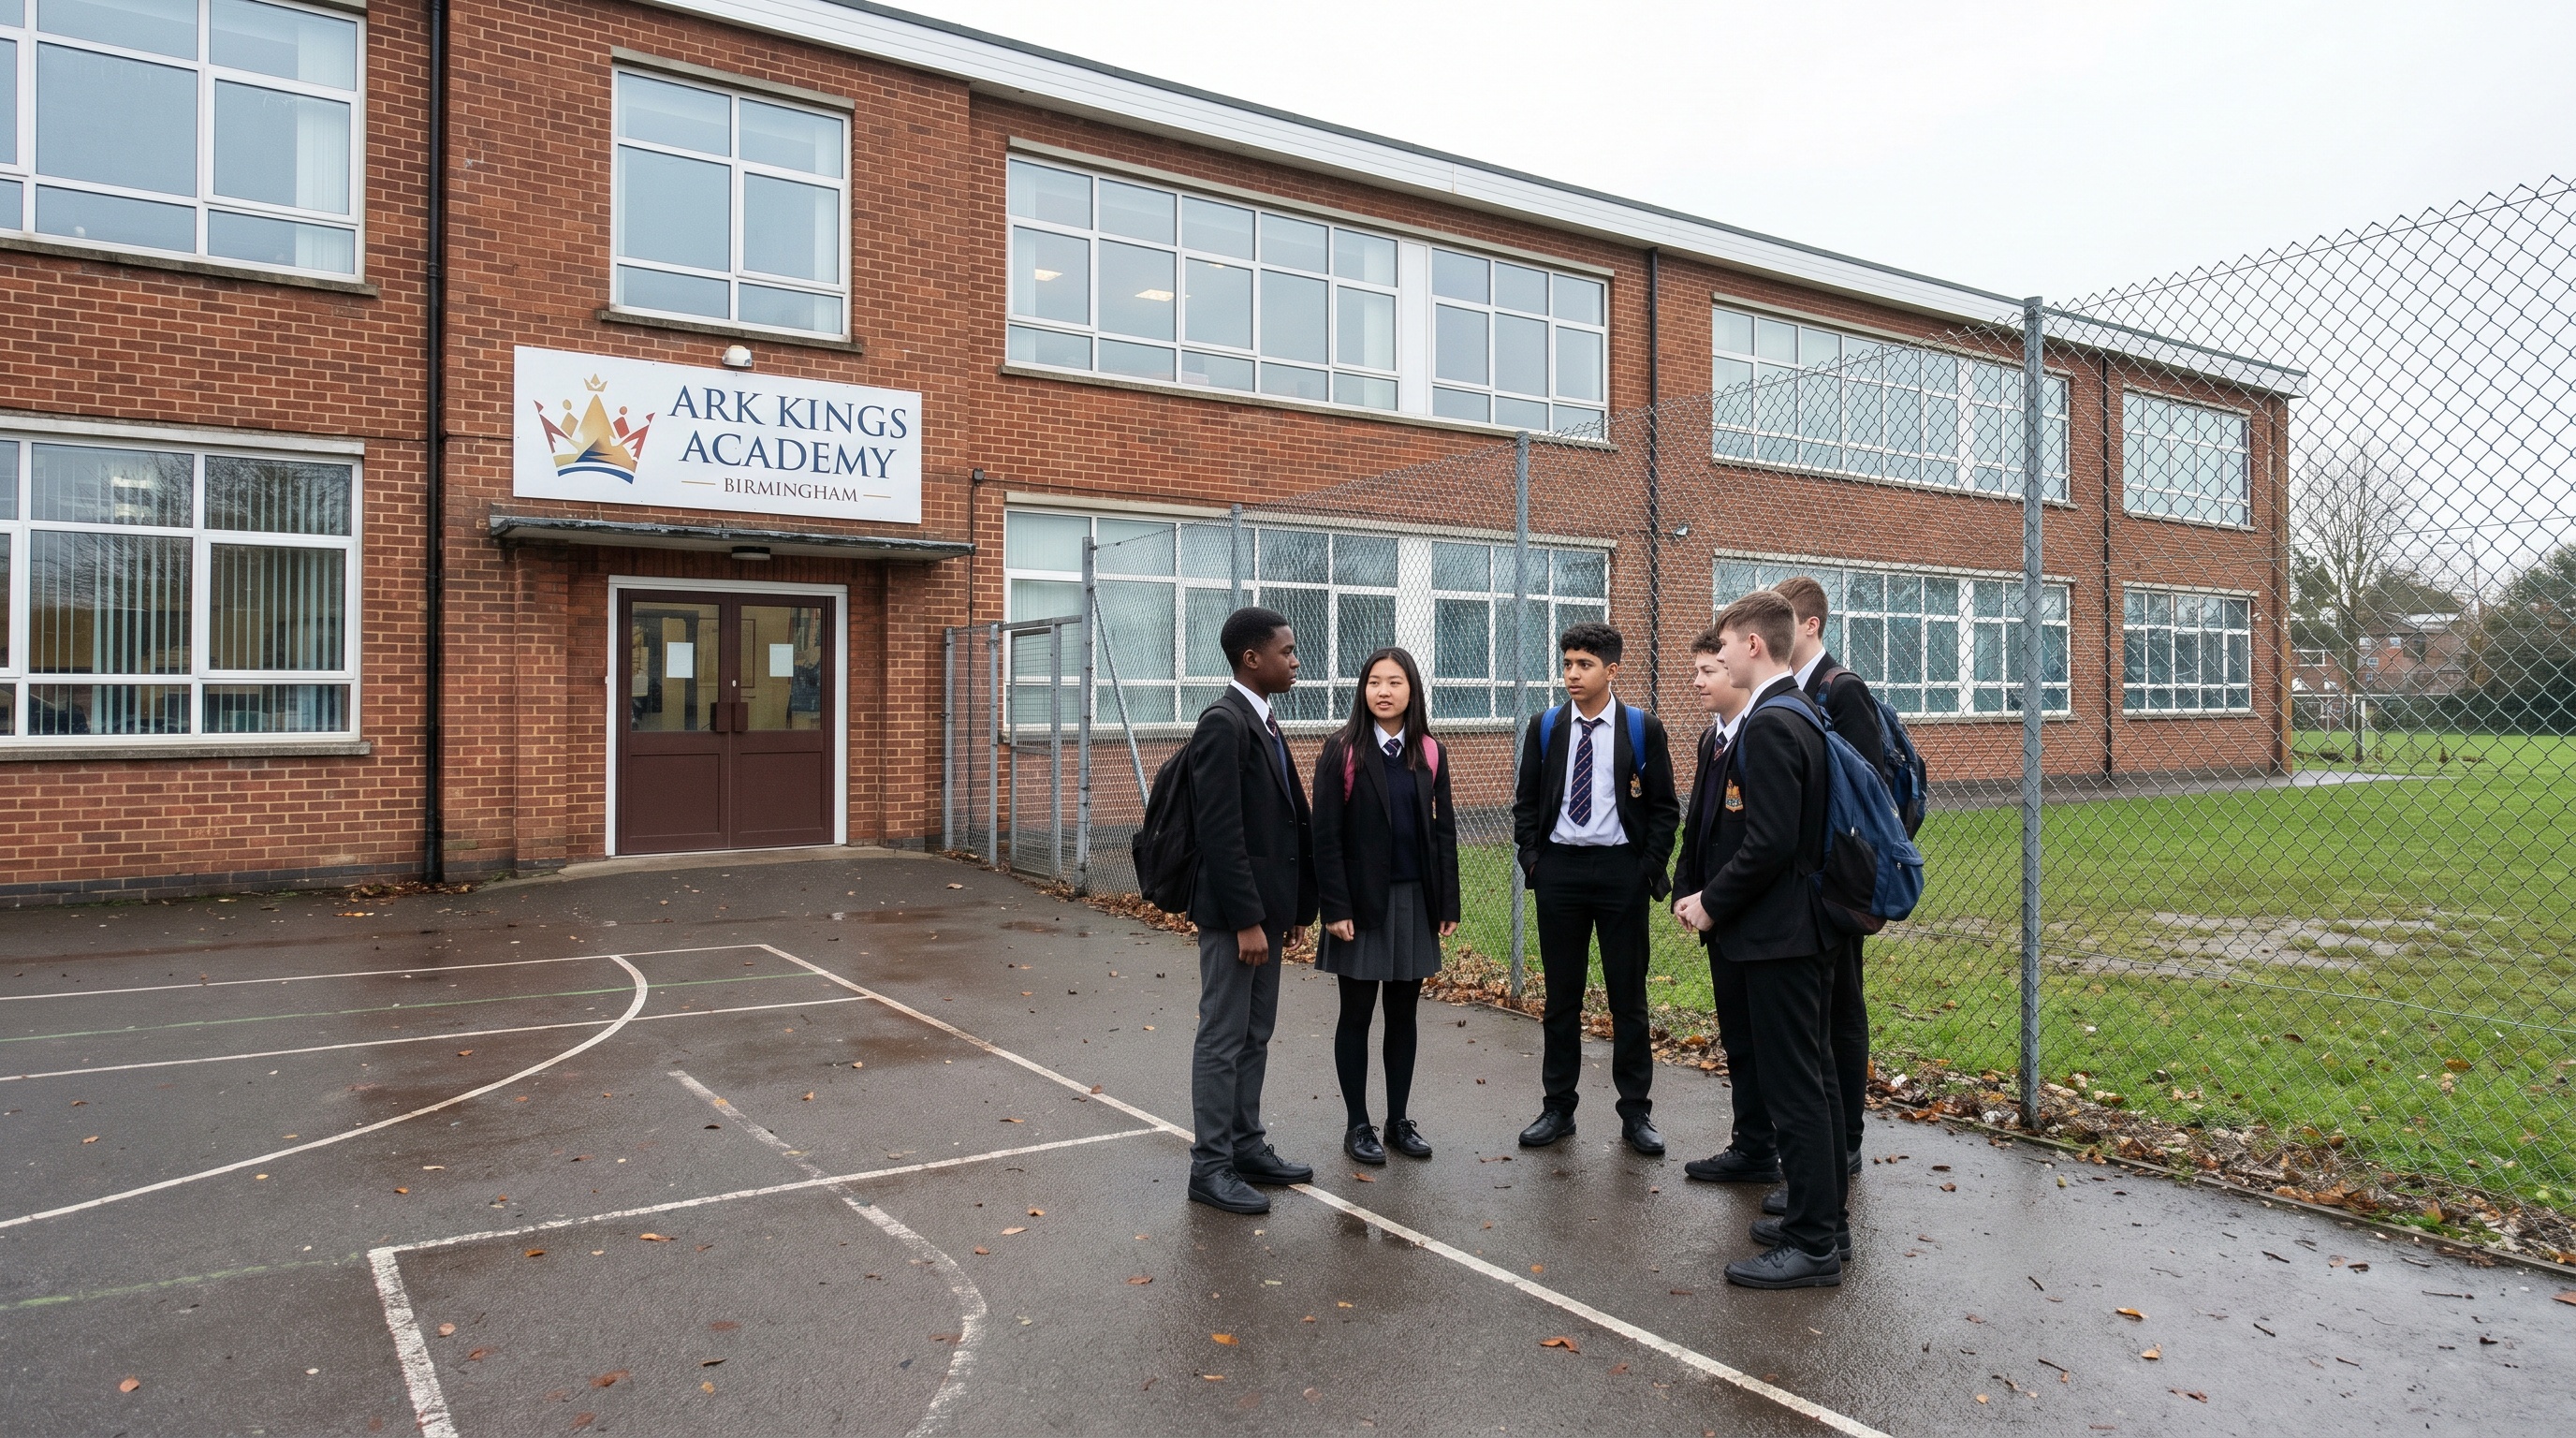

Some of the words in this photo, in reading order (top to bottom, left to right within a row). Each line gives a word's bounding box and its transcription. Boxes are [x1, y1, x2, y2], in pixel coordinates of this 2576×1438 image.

[666, 385, 767, 426] ARK
[776, 395, 907, 439] KINGS
[678, 430, 898, 479] ACADEMY
[724, 477, 858, 503] BIRMINGHAM
